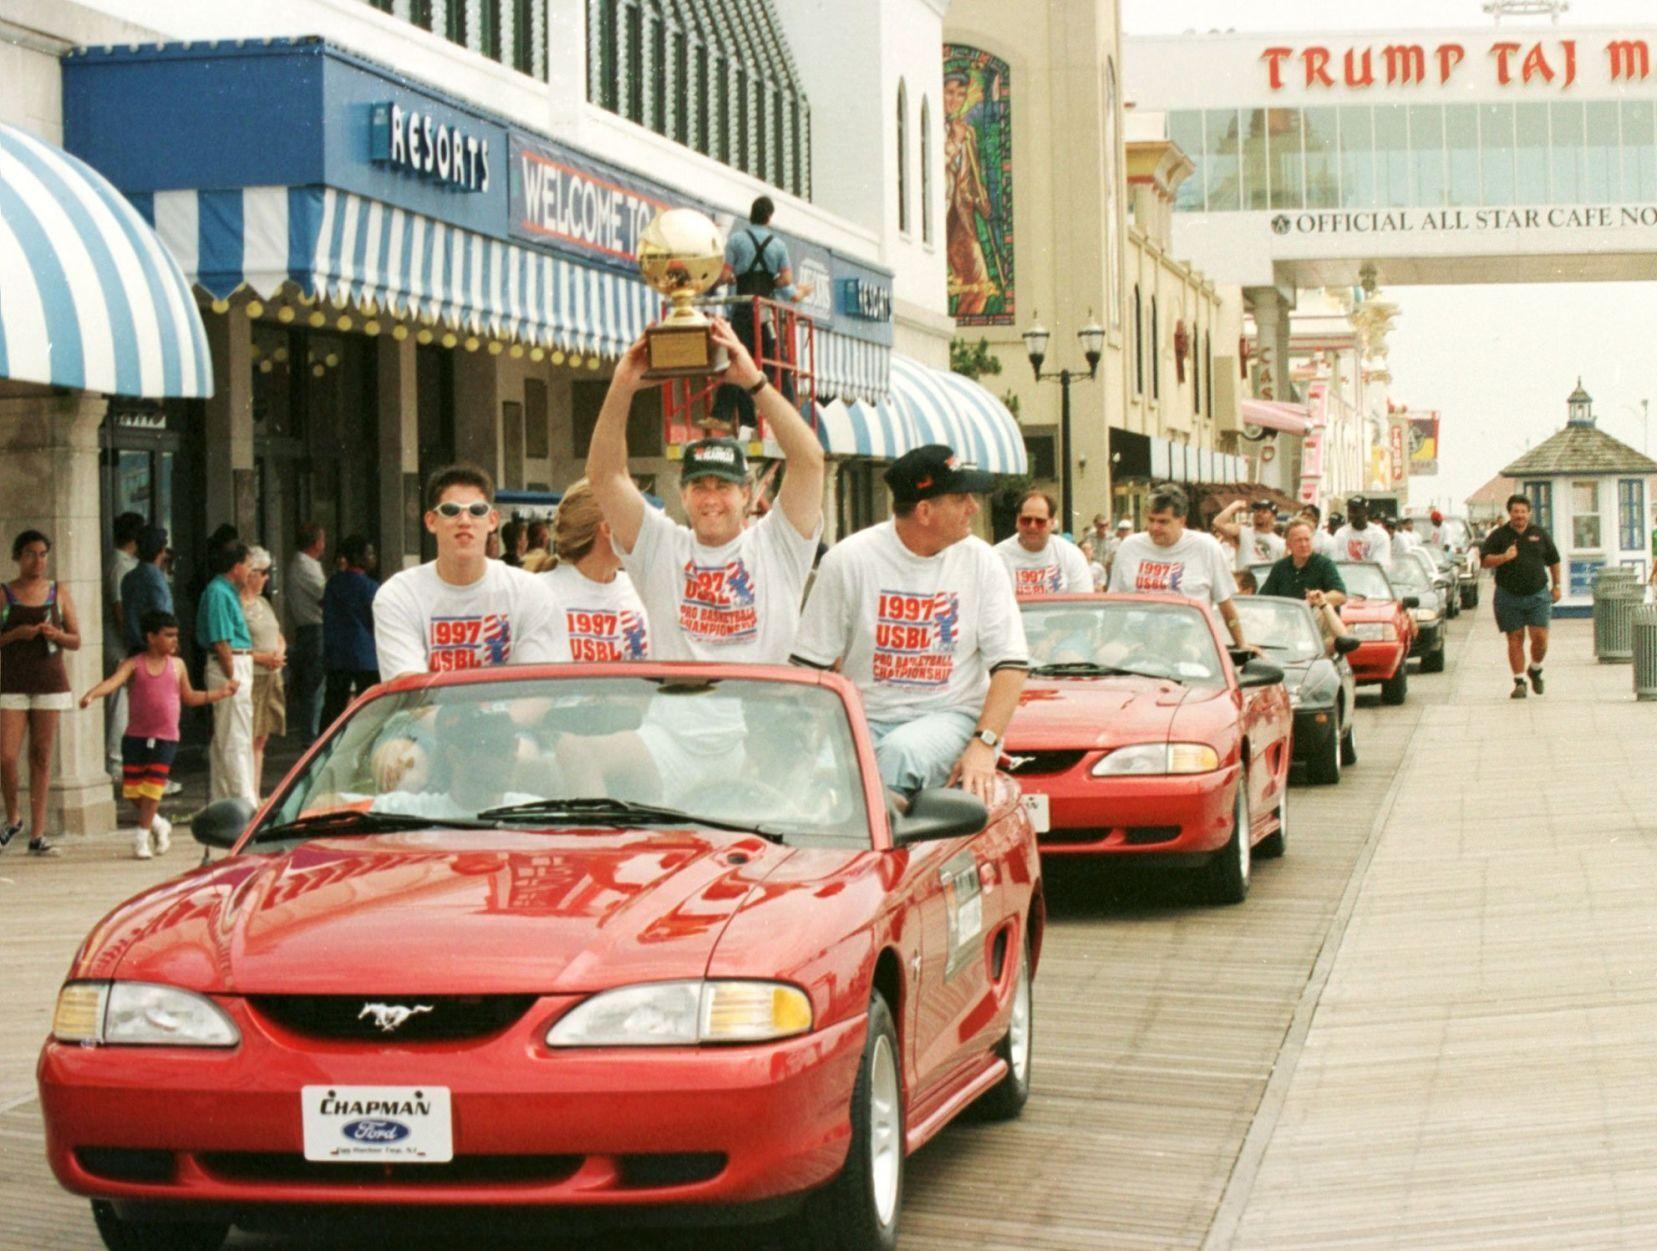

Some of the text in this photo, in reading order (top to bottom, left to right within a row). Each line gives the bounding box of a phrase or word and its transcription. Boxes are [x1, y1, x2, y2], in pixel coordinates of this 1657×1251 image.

[1260, 43, 1465, 90] TRUMP
[1488, 40, 1576, 89] TAJ
[391, 103, 489, 193] RESORTS
[522, 155, 623, 251] WELCOME
[1296, 212, 1413, 234] OFFICIAL
[1422, 211, 1469, 231] ALL
[1476, 209, 1541, 229] STAR
[1547, 207, 1613, 228] CAFE
[1016, 569, 1045, 583] 1997
[1139, 562, 1170, 577] 1997
[878, 595, 935, 621] 1997
[431, 621, 482, 645] 1997
[567, 613, 617, 636] 1997
[876, 624, 932, 649] USBL
[429, 649, 482, 672] USBL
[570, 638, 622, 661] USBL
[320, 1099, 431, 1116] CHAPMAN
[354, 1120, 397, 1140] Ford
